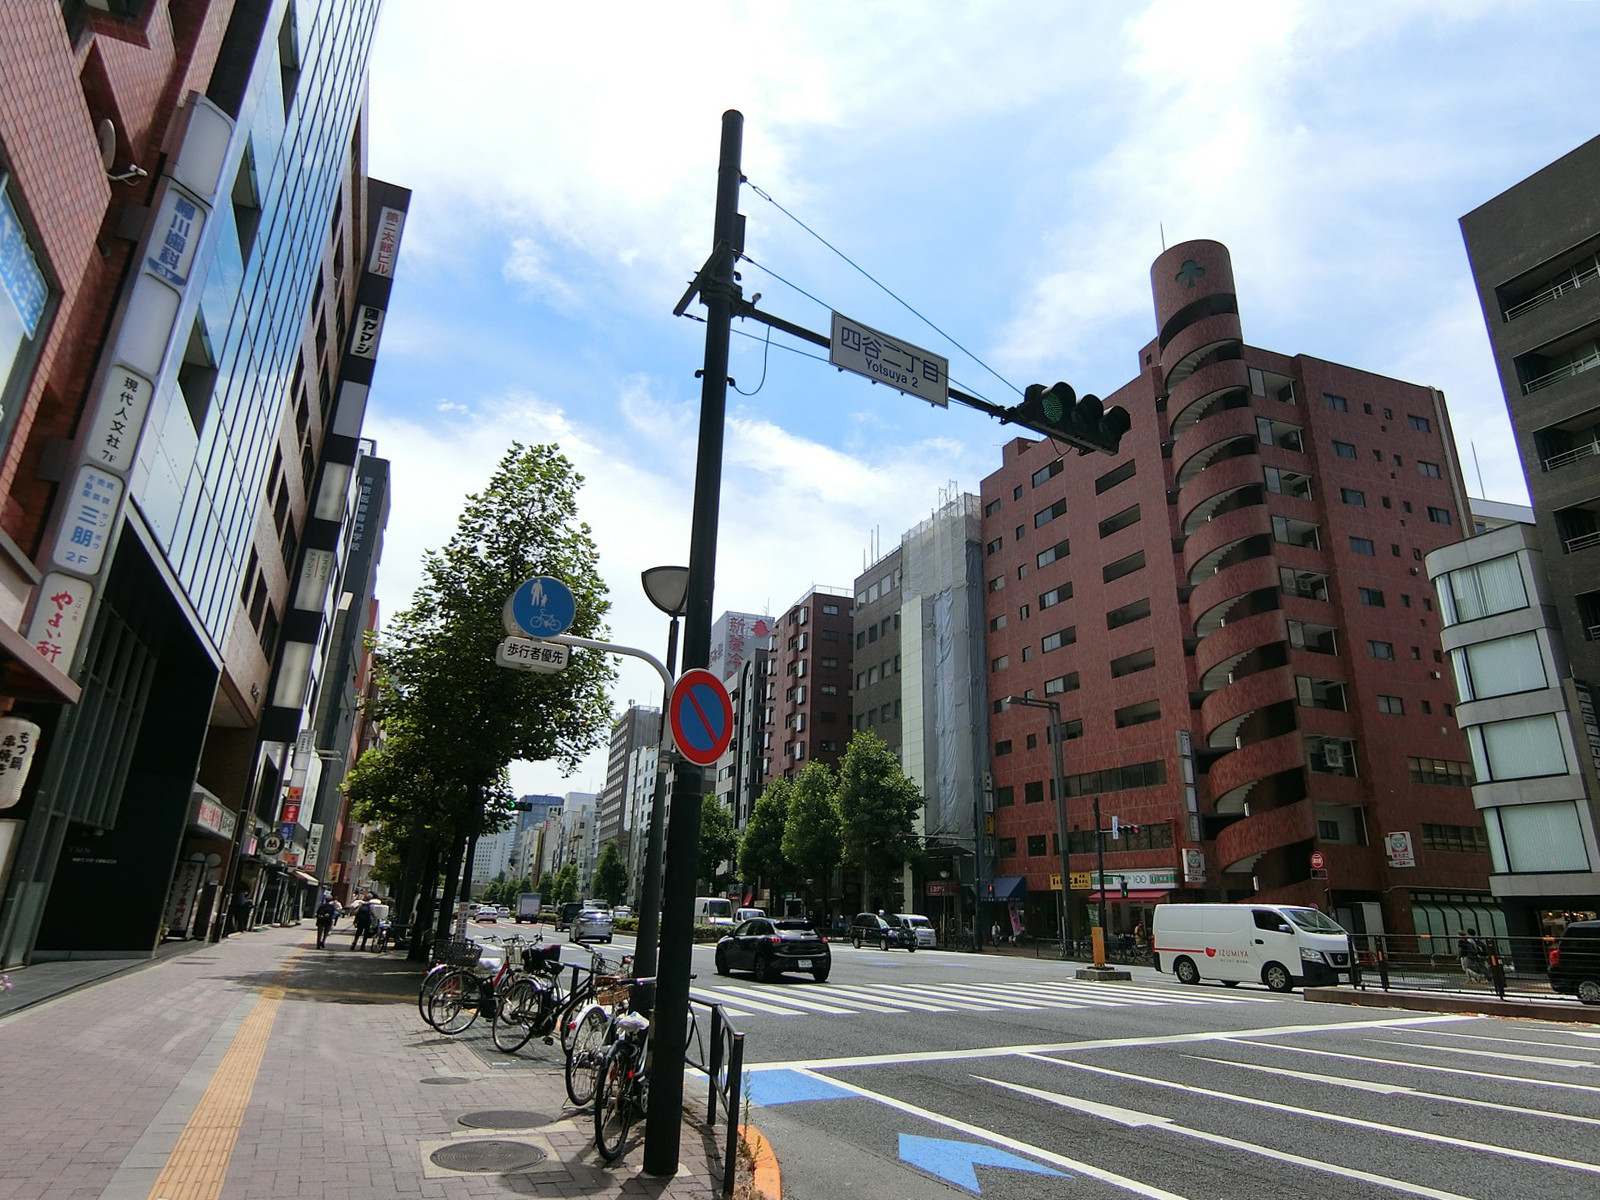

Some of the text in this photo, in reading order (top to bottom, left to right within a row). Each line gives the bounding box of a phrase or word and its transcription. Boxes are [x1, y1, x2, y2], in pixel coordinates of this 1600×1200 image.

[355, 320, 377, 354] ヤマジ
[841, 326, 939, 384] 四谷二丁目
[865, 358, 920, 389] Yotsuya 2
[106, 377, 139, 450] 現代人文社
[102, 449, 117, 462] 7F
[71, 504, 100, 548] 三朋
[65, 551, 89, 564] 2F
[36, 590, 74, 664] やよい軒
[507, 642, 564, 665] 歩行者優先
[1218, 949, 1249, 958] IZUMIYA
